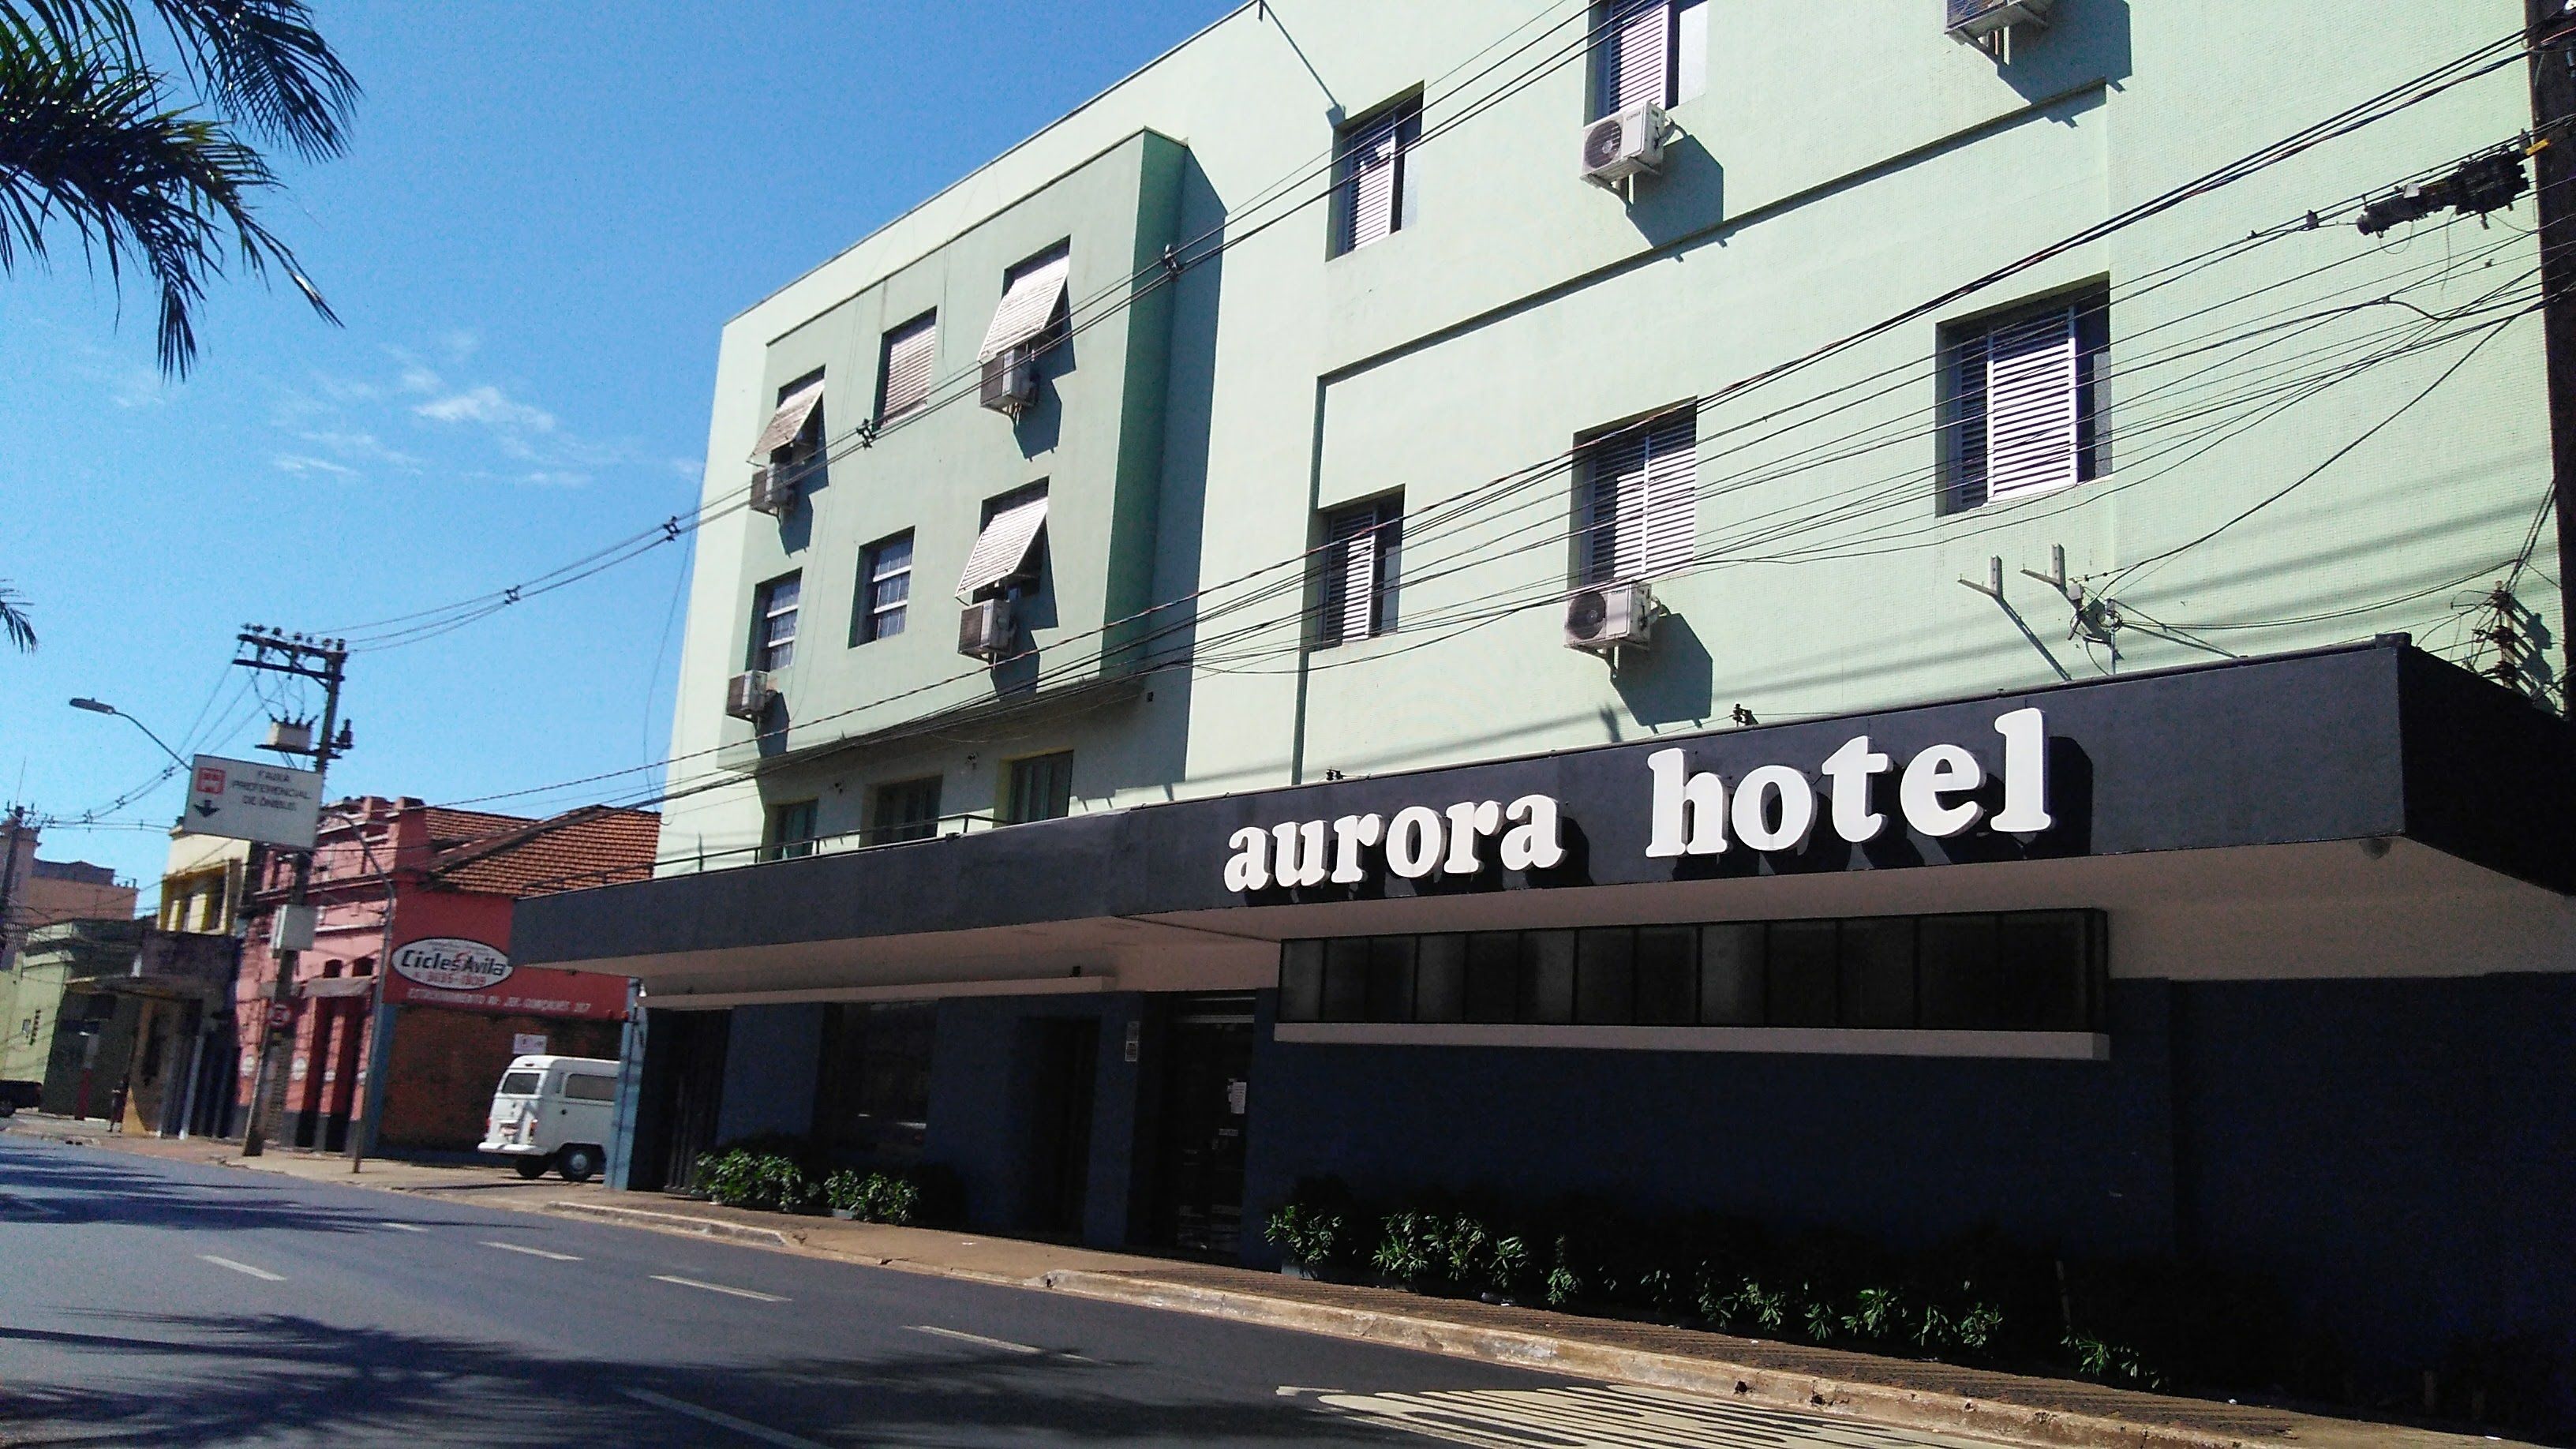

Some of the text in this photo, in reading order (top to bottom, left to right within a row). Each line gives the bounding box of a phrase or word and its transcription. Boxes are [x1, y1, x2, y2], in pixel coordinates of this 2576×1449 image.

[257, 769, 290, 782] FAIXA
[231, 780, 311, 799] PREFERENCIAL
[242, 795, 256, 806] DE
[1223, 707, 2051, 893] aurora hotel
[401, 949, 461, 972] Cicles
